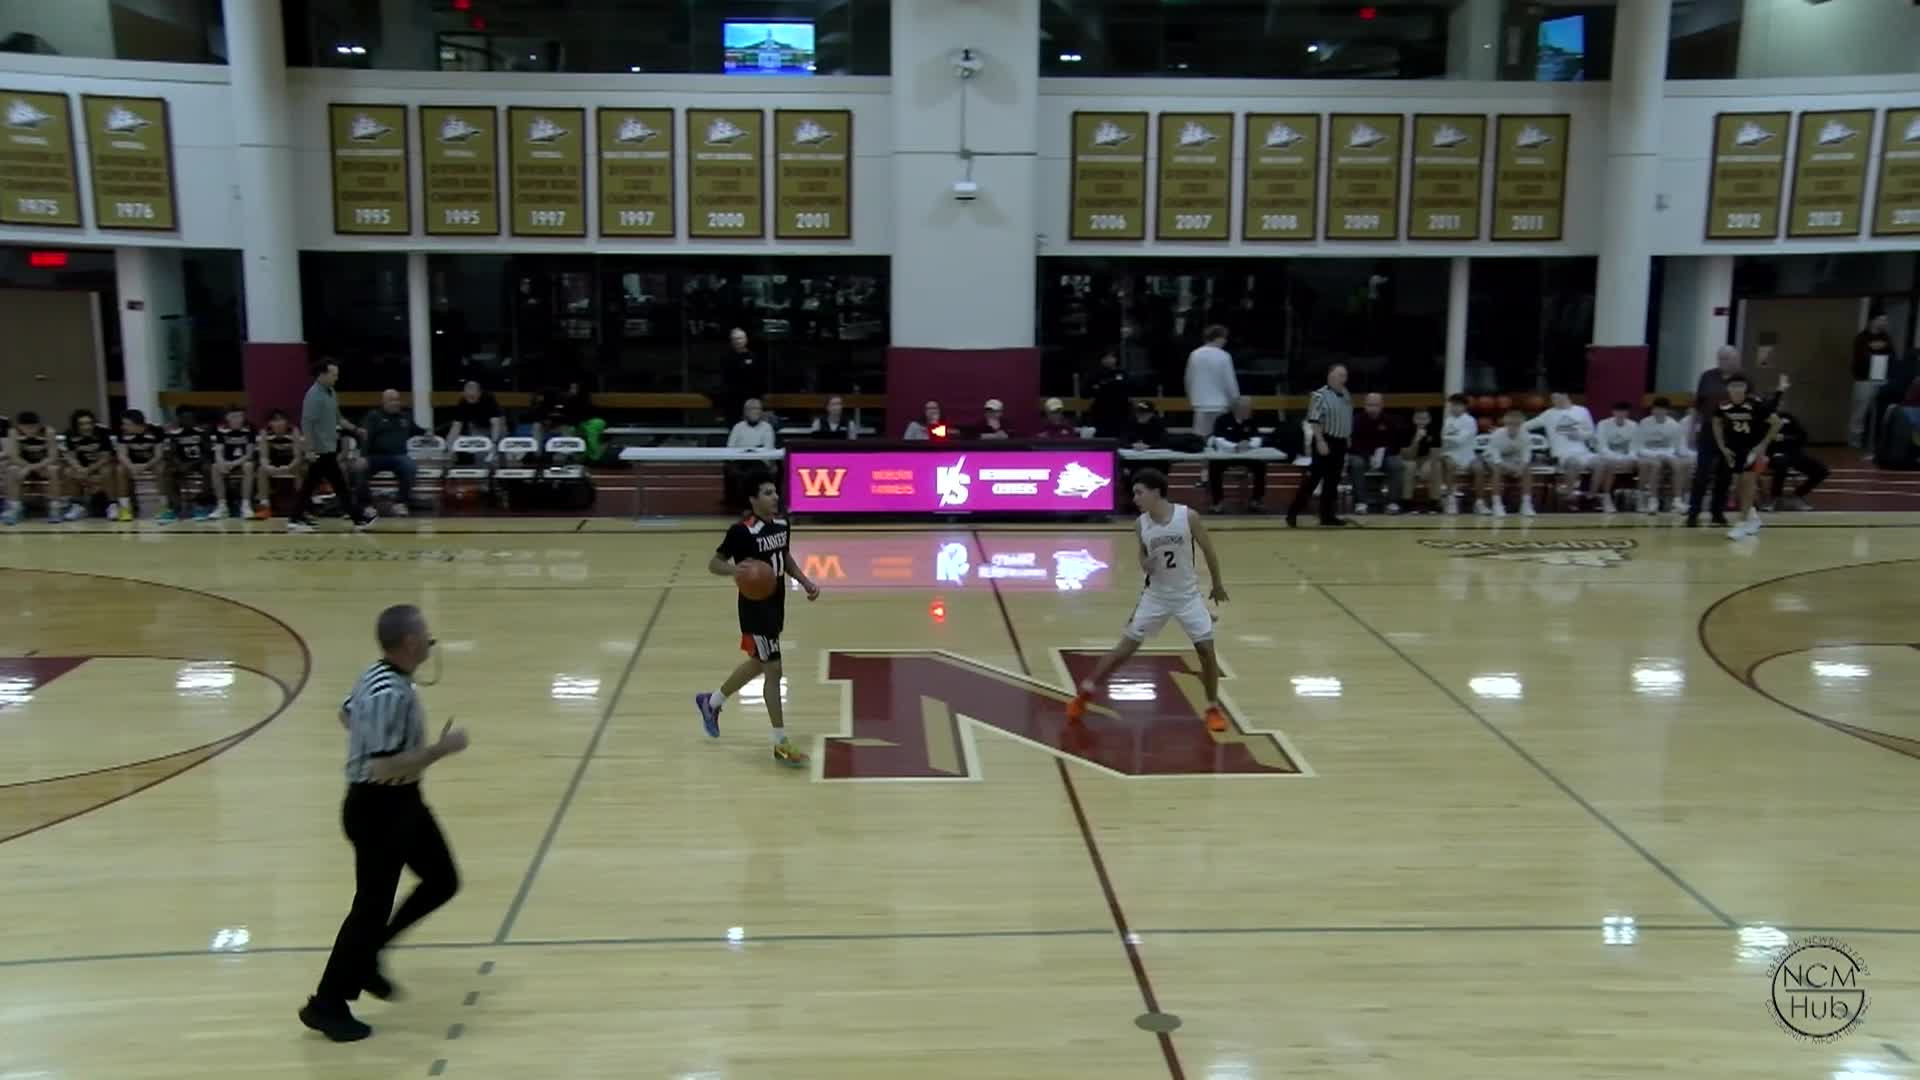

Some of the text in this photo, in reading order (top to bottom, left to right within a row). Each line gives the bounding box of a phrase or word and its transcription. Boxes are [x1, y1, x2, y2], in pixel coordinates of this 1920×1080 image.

[115, 202, 155, 219] 1976
[355, 209, 391, 225] 1995
[445, 209, 480, 225] 1995
[531, 210, 566, 226] 1997
[620, 210, 655, 226] 1997
[707, 212, 745, 228] 2000
[796, 212, 830, 228] 2001
[1090, 214, 1127, 230] 2006
[1175, 214, 1212, 230] 2007
[797, 468, 848, 498] W
[1163, 551, 1177, 569] 2
[815, 648, 1314, 780] N
